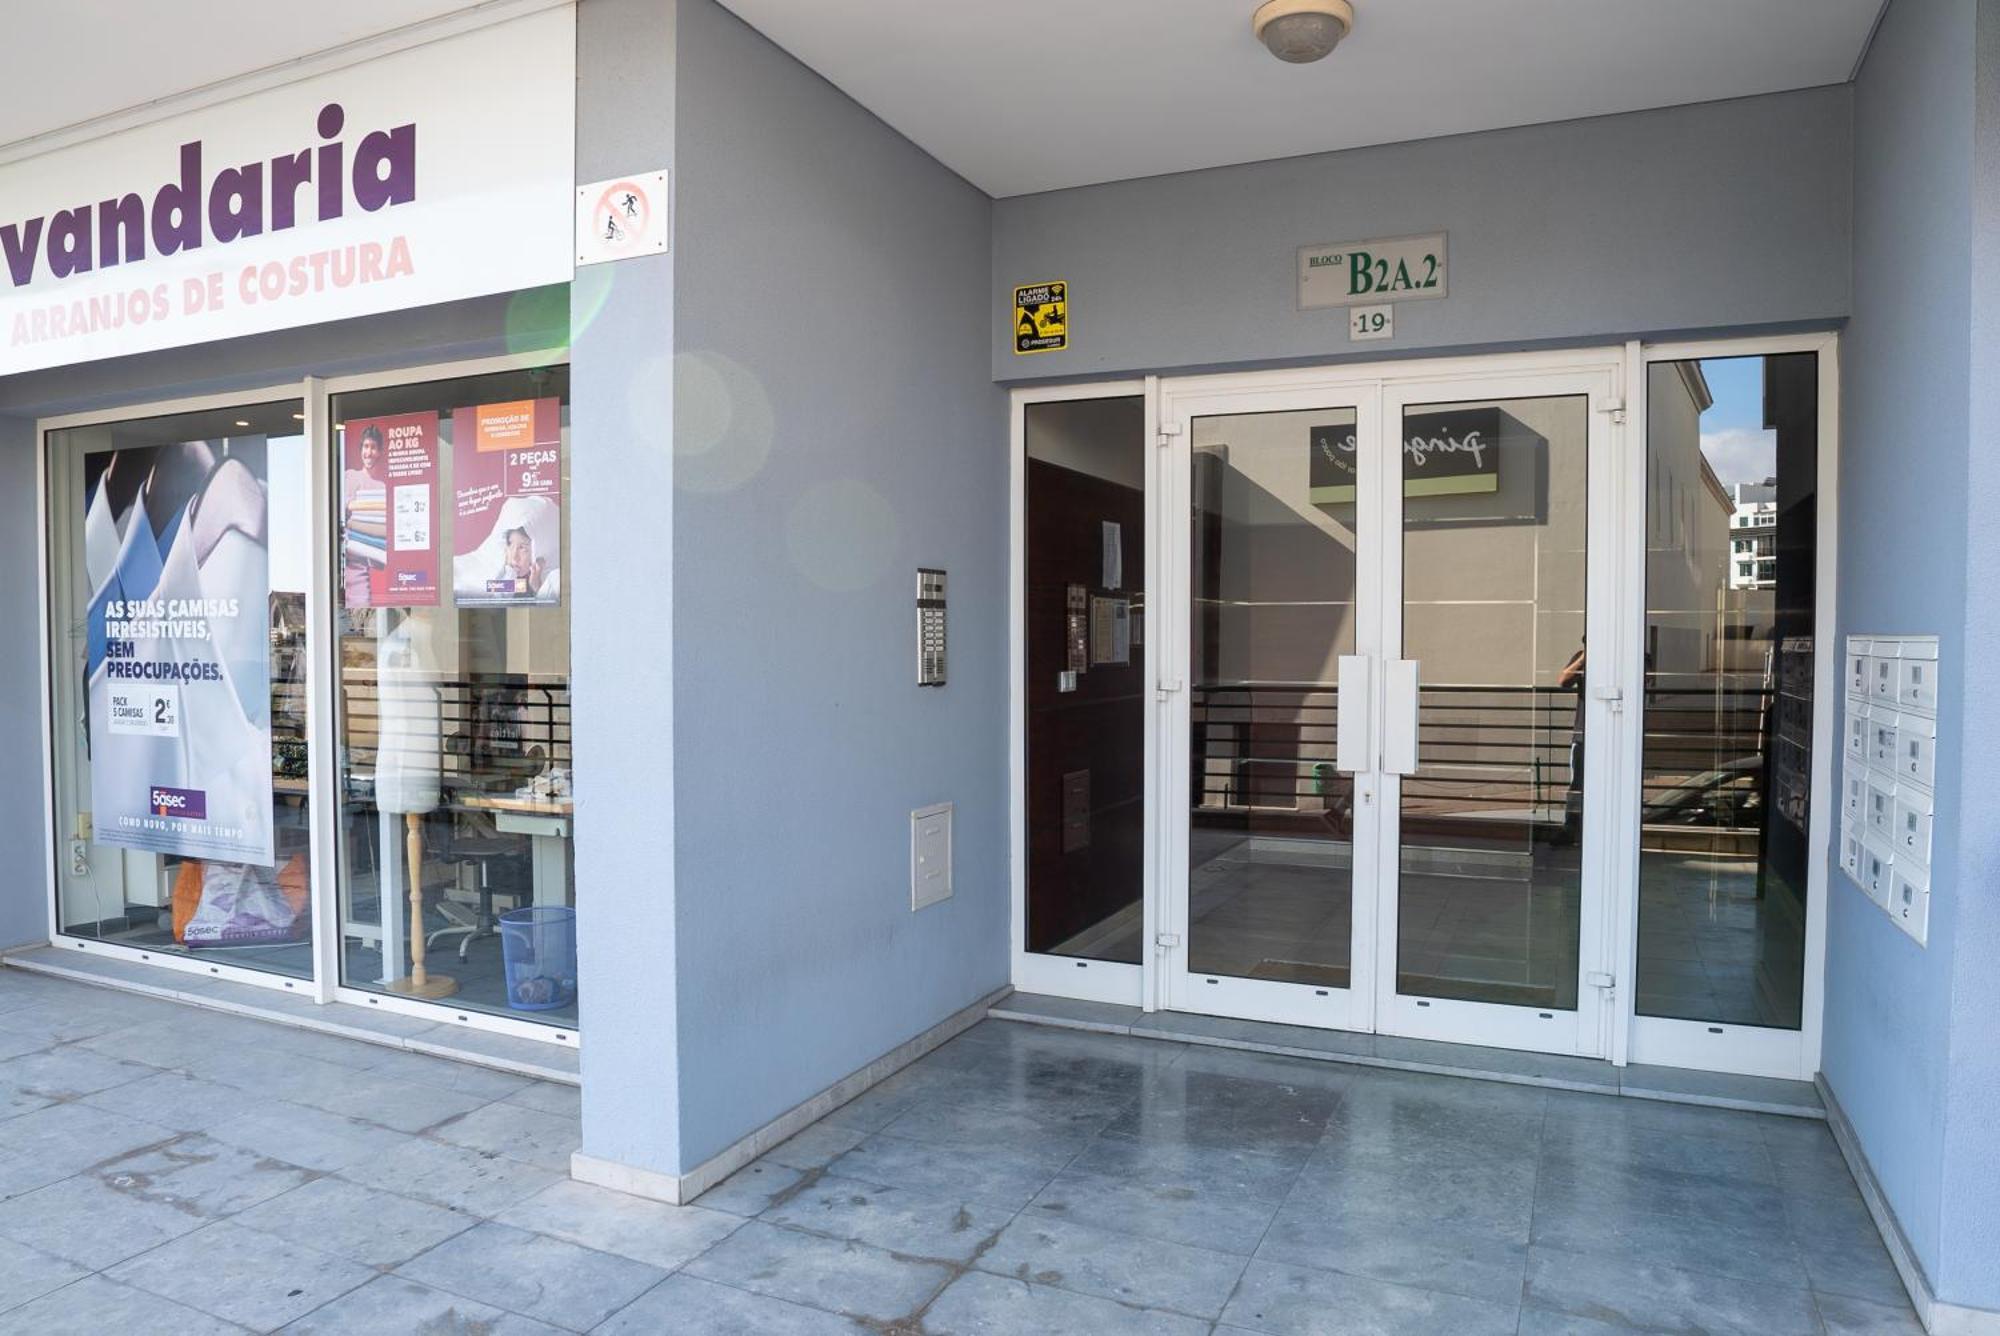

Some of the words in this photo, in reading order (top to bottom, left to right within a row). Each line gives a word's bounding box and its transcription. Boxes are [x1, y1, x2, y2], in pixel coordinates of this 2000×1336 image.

[0, 103, 416, 288] vandaria
[1309, 254, 1342, 267] BLOCO
[1347, 252, 1437, 295] B2A.2
[10, 283, 171, 347] ARRANJOS
[183, 271, 224, 316] DE
[239, 235, 414, 305] COSTURA
[1018, 287, 1049, 297] ALARME
[1018, 294, 1050, 304] LIGADO
[1357, 312, 1385, 333] 19
[388, 425, 423, 440] ROUPA
[388, 439, 403, 450] AO
[404, 436, 420, 449] KG
[510, 453, 518, 466] 2
[519, 450, 557, 466] PEÇAS
[522, 472, 531, 488] 9
[105, 600, 124, 618] AS
[127, 600, 165, 618] SUAS
[168, 599, 239, 617] CAMISAS
[106, 641, 135, 658] SEM
[107, 659, 223, 685] PREOCUPAÇÕES.
[113, 696, 128, 706] PACK
[155, 698, 166, 723] 2
[119, 708, 143, 718] CAMISAS
[119, 815, 141, 829] COMO
